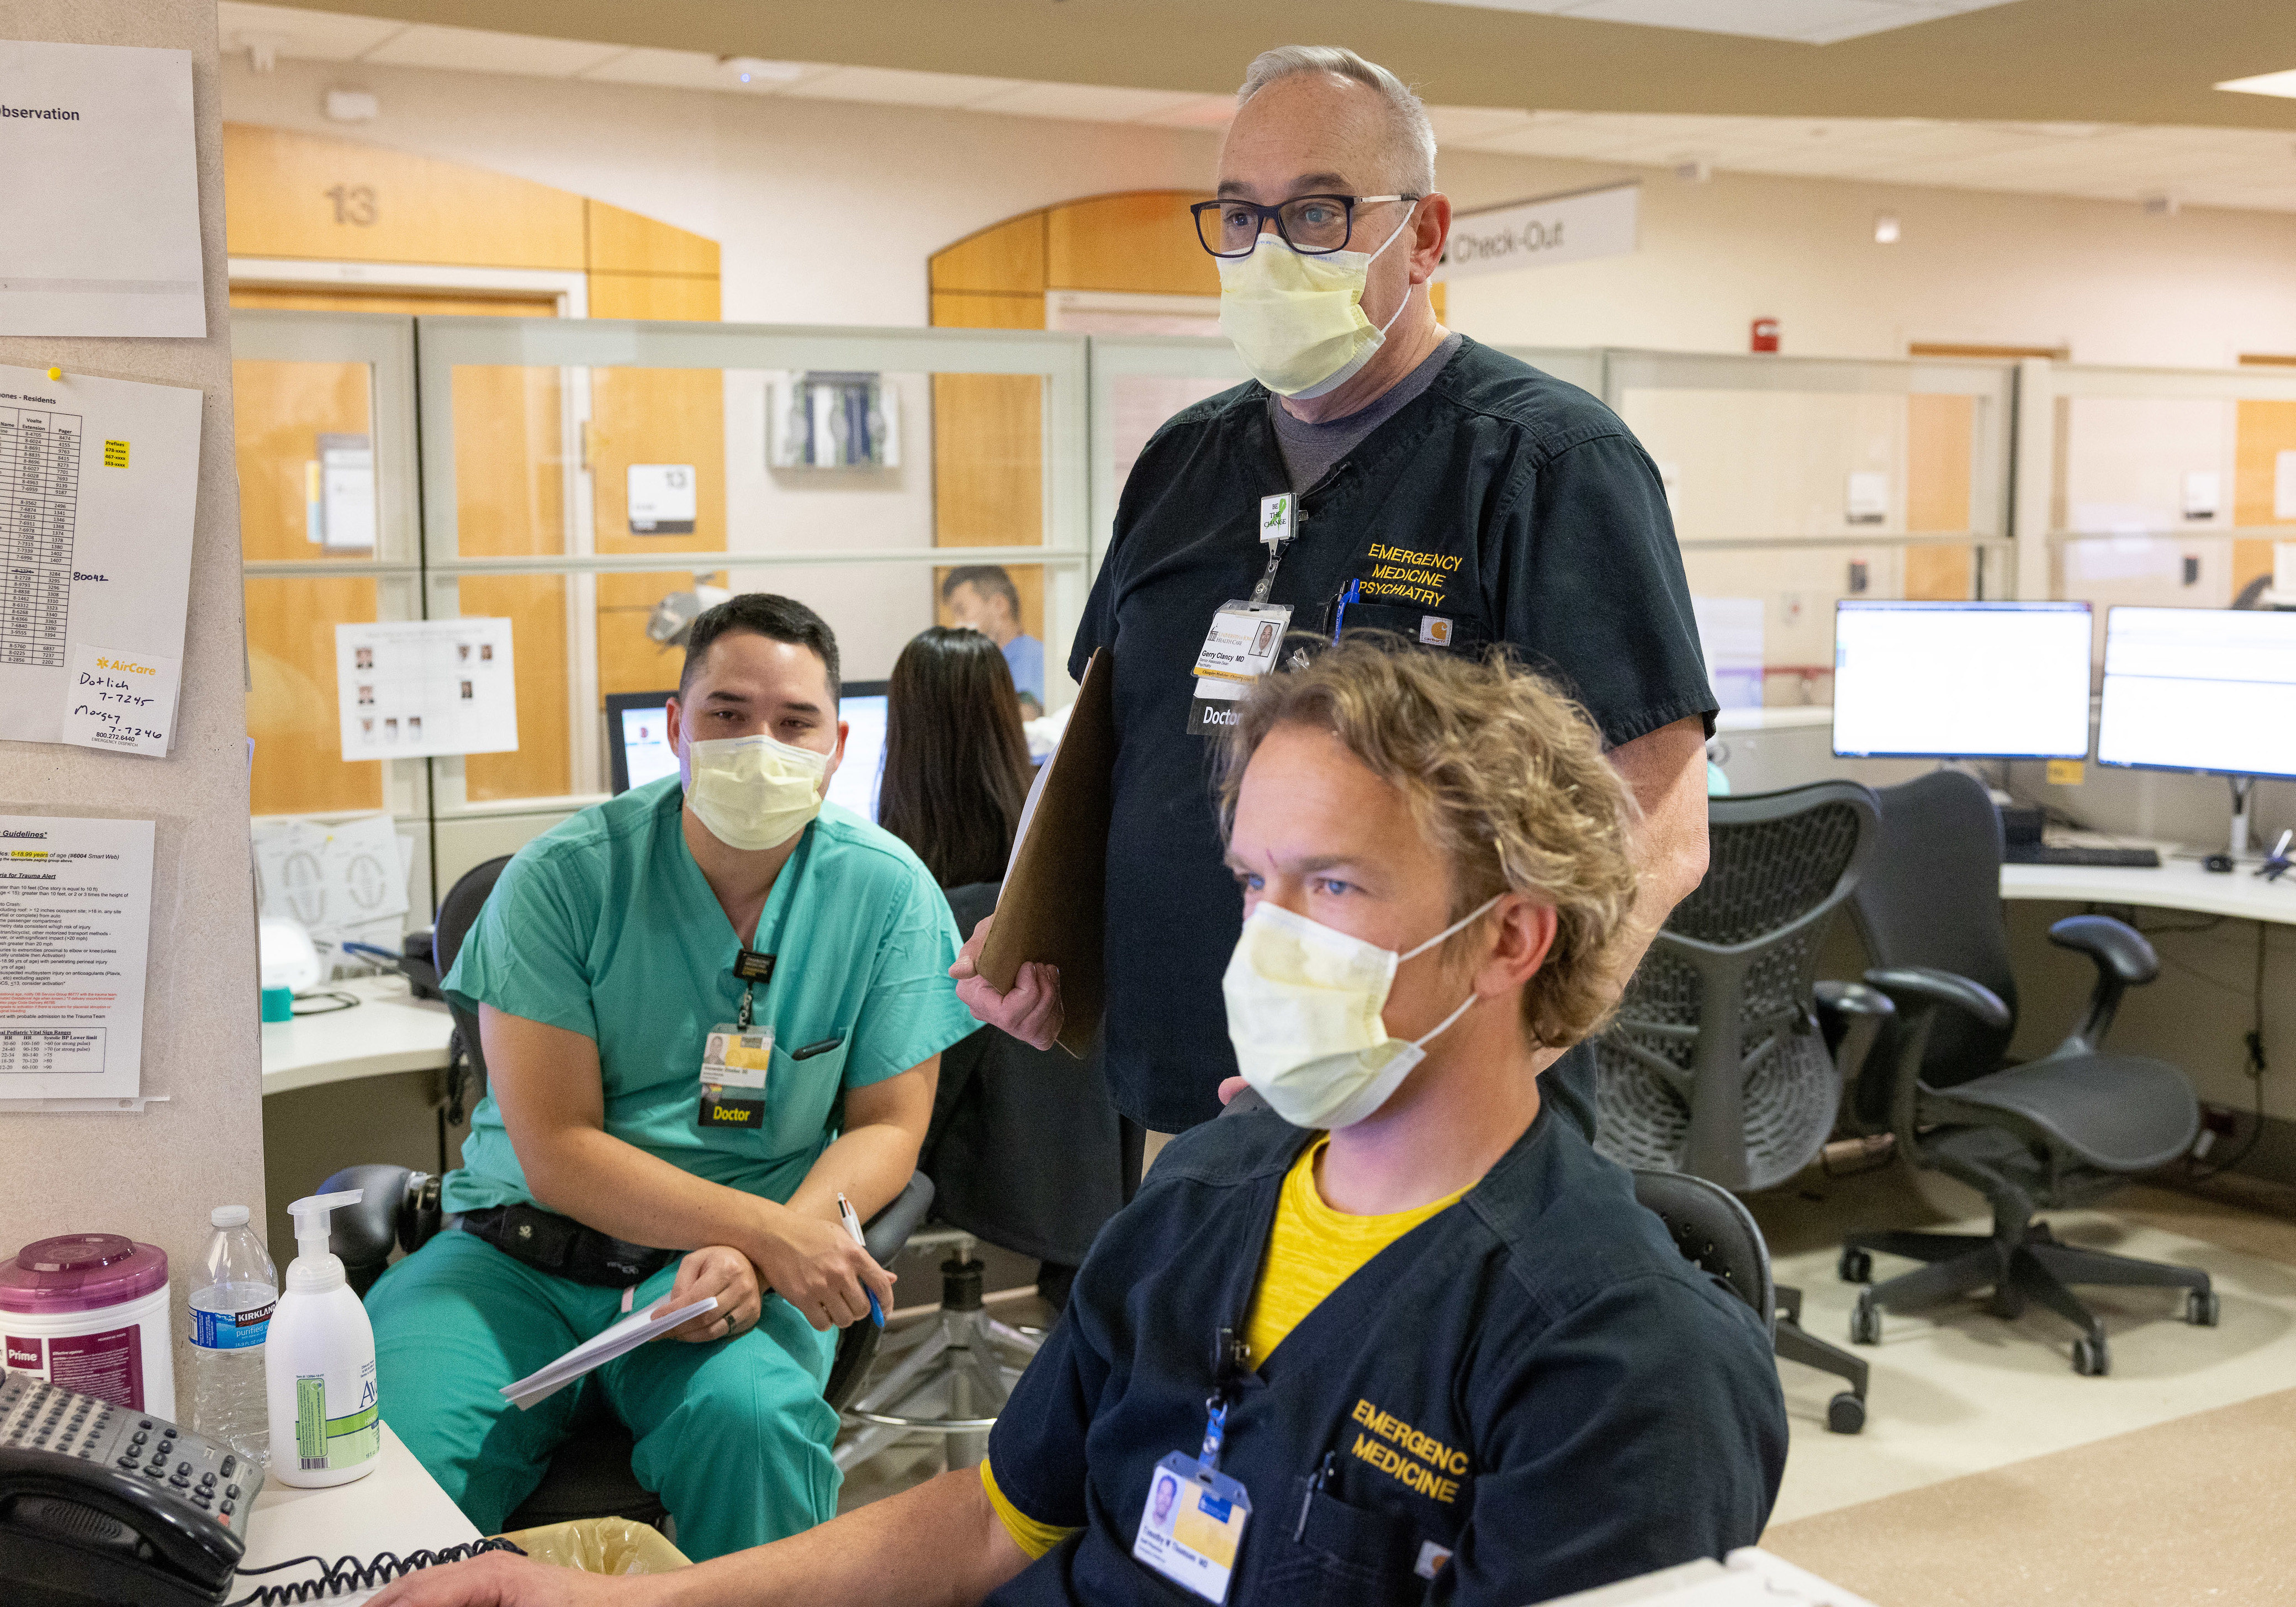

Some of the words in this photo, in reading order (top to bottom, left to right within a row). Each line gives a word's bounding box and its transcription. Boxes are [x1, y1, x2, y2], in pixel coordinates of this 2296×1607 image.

[0, 105, 80, 120] bservation
[326, 183, 379, 228] 13
[1453, 221, 1564, 263] Check-Out
[23, 395, 56, 404] Residents
[1264, 519, 1286, 527] CHANGE
[1368, 543, 1463, 572] EMERGENCY
[73, 572, 109, 582] 80042
[1372, 564, 1446, 587] MEDICINE
[1358, 582, 1446, 607] PSYCHIATRY
[1202, 650, 1216, 659] Gerry
[1216, 652, 1234, 662] Clancy
[110, 660, 156, 675] AirCare
[99, 692, 154, 706] 7-7245
[1203, 706, 1242, 725] Doctor
[96, 732, 135, 742] 800.272.6440
[109, 726, 162, 739] 7-7246
[713, 1106, 750, 1121] Doctor
[238, 1304, 276, 1321] KIRKLAND
[237, 1324, 263, 1338] purified
[9, 1349, 37, 1361] Prime
[1352, 1399, 1468, 1475] EMERGENC
[1351, 1432, 1460, 1504] MEDICINE
